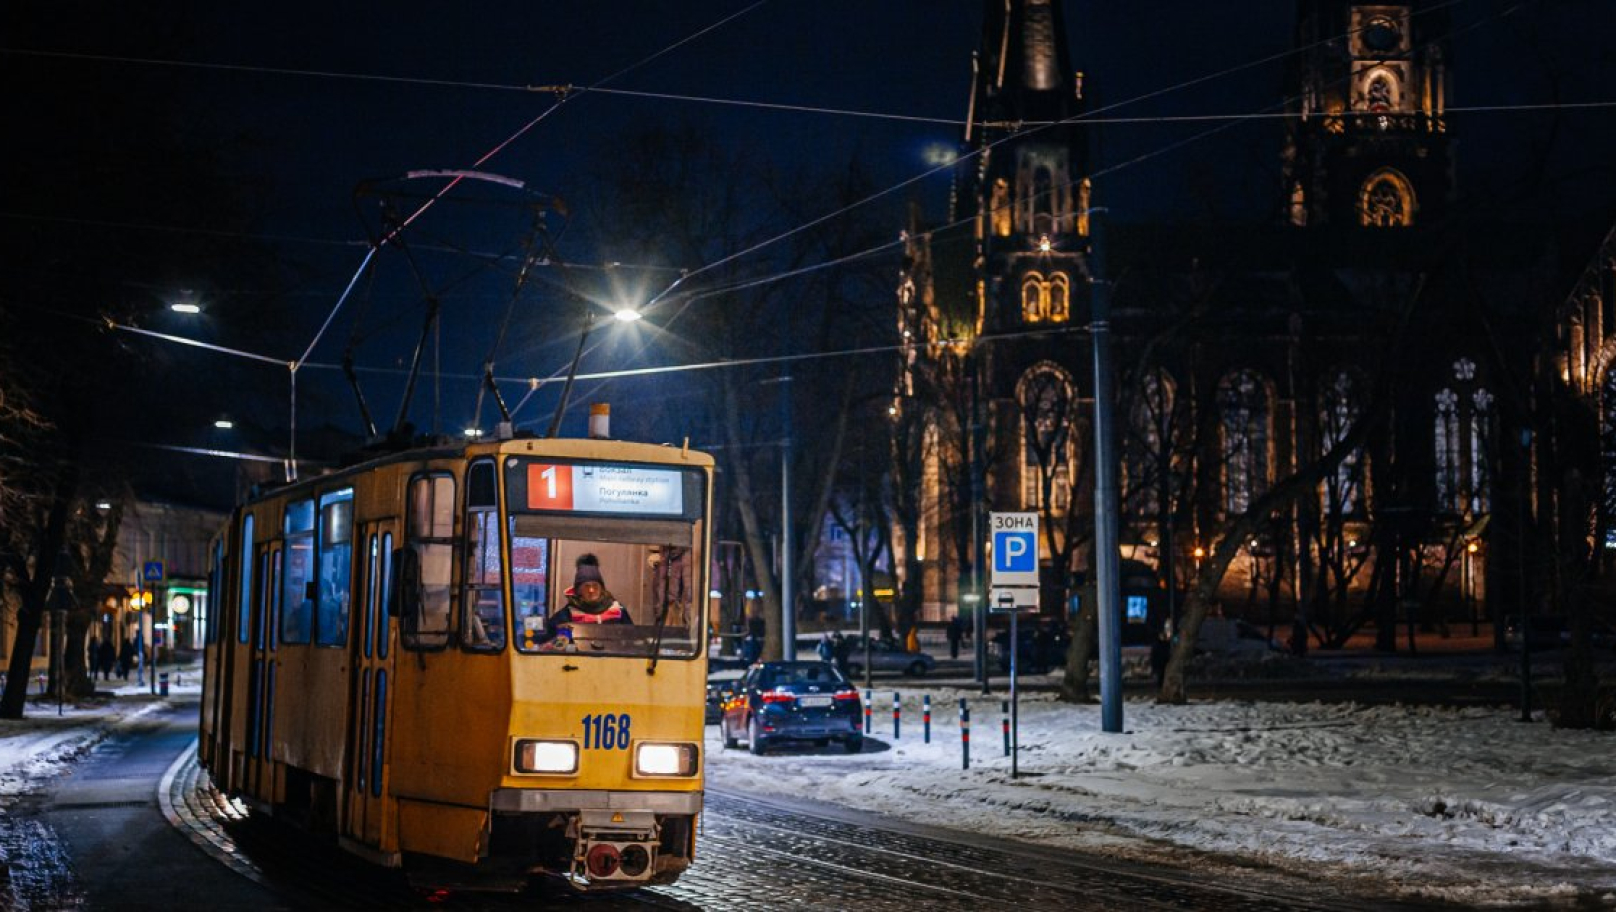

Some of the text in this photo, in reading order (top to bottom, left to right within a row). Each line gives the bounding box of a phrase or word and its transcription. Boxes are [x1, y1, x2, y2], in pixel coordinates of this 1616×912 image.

[541, 465, 557, 499] 1
[599, 487, 648, 497] Погулянка
[995, 517, 1034, 529] ЗОНА
[1005, 536, 1027, 567] P
[582, 714, 631, 750] 1168
